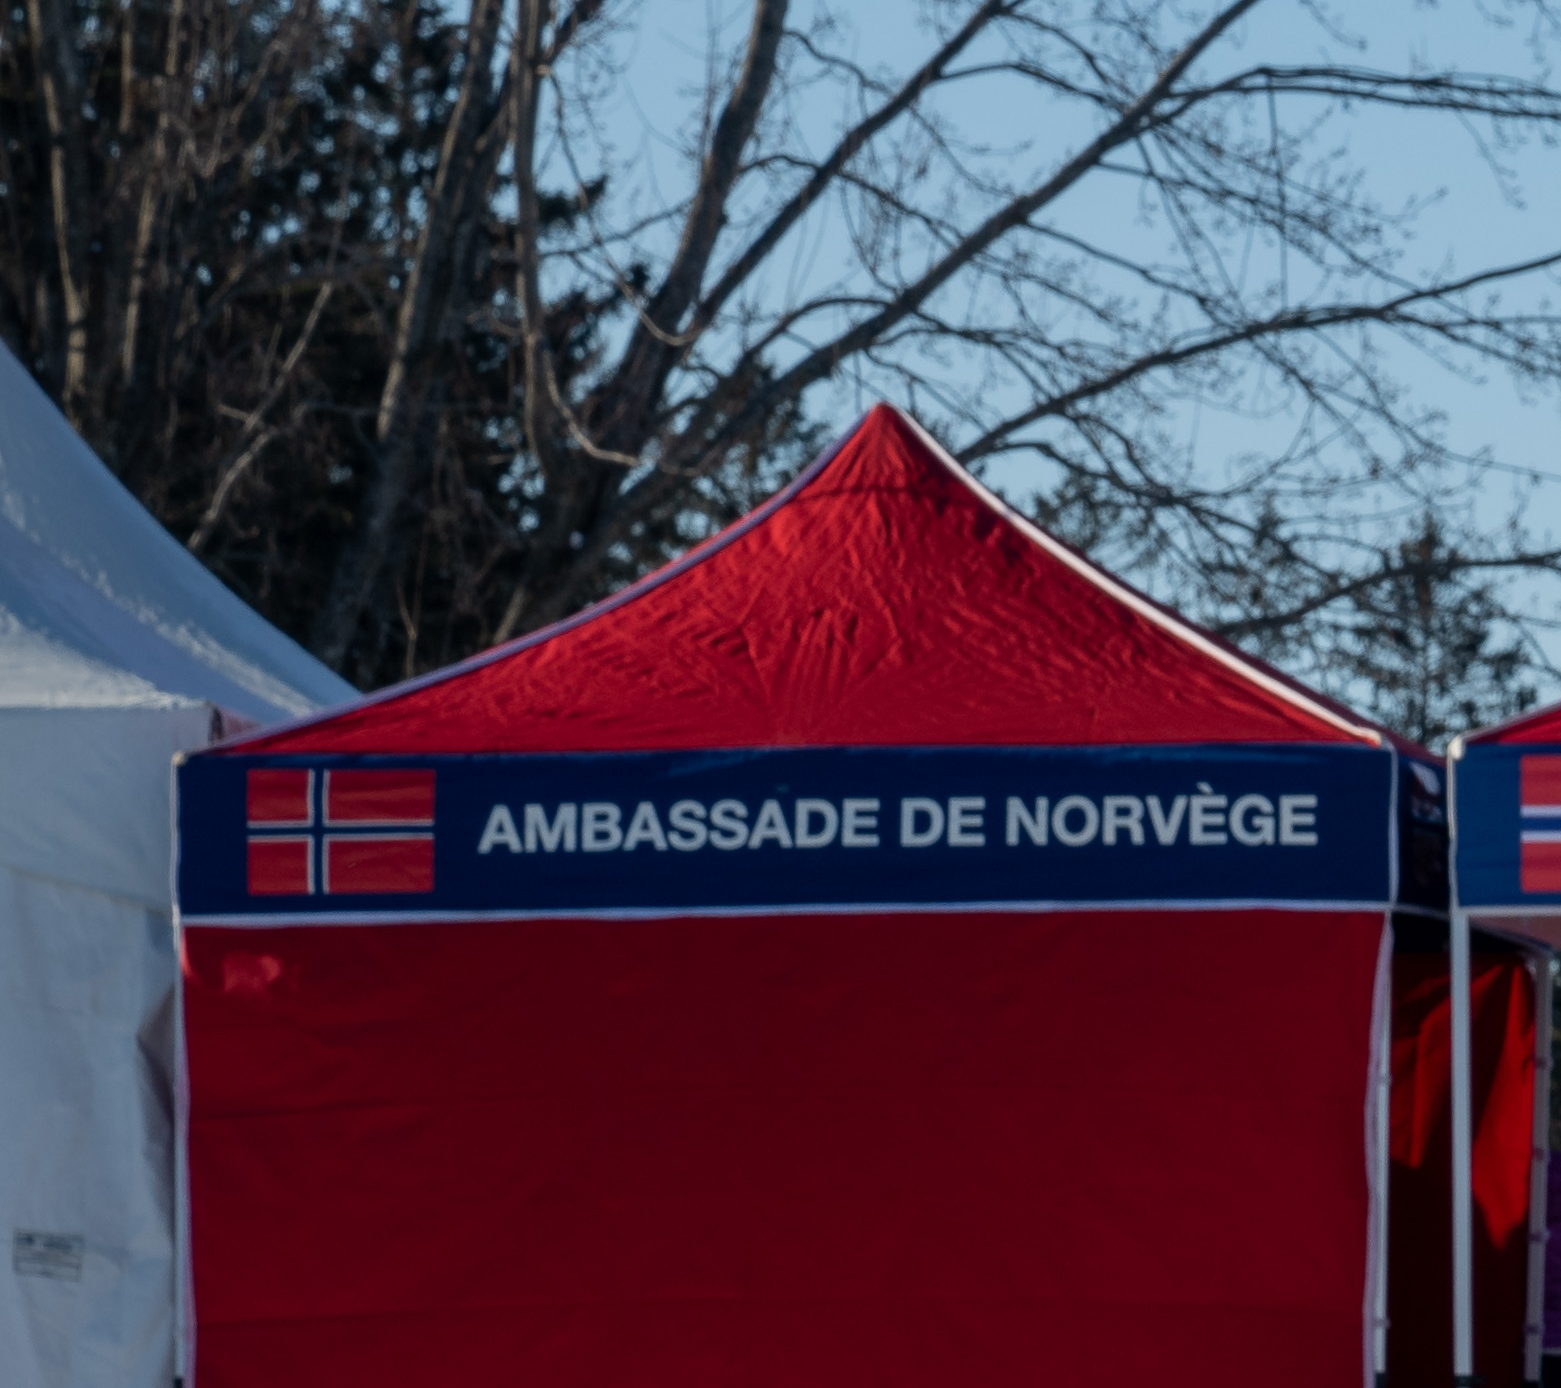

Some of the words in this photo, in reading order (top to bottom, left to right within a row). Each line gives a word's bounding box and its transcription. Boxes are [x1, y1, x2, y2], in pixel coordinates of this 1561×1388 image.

[478, 798, 881, 854] AMBASSADE
[900, 797, 986, 847] DE
[1005, 783, 1319, 848] NORVÈGE
